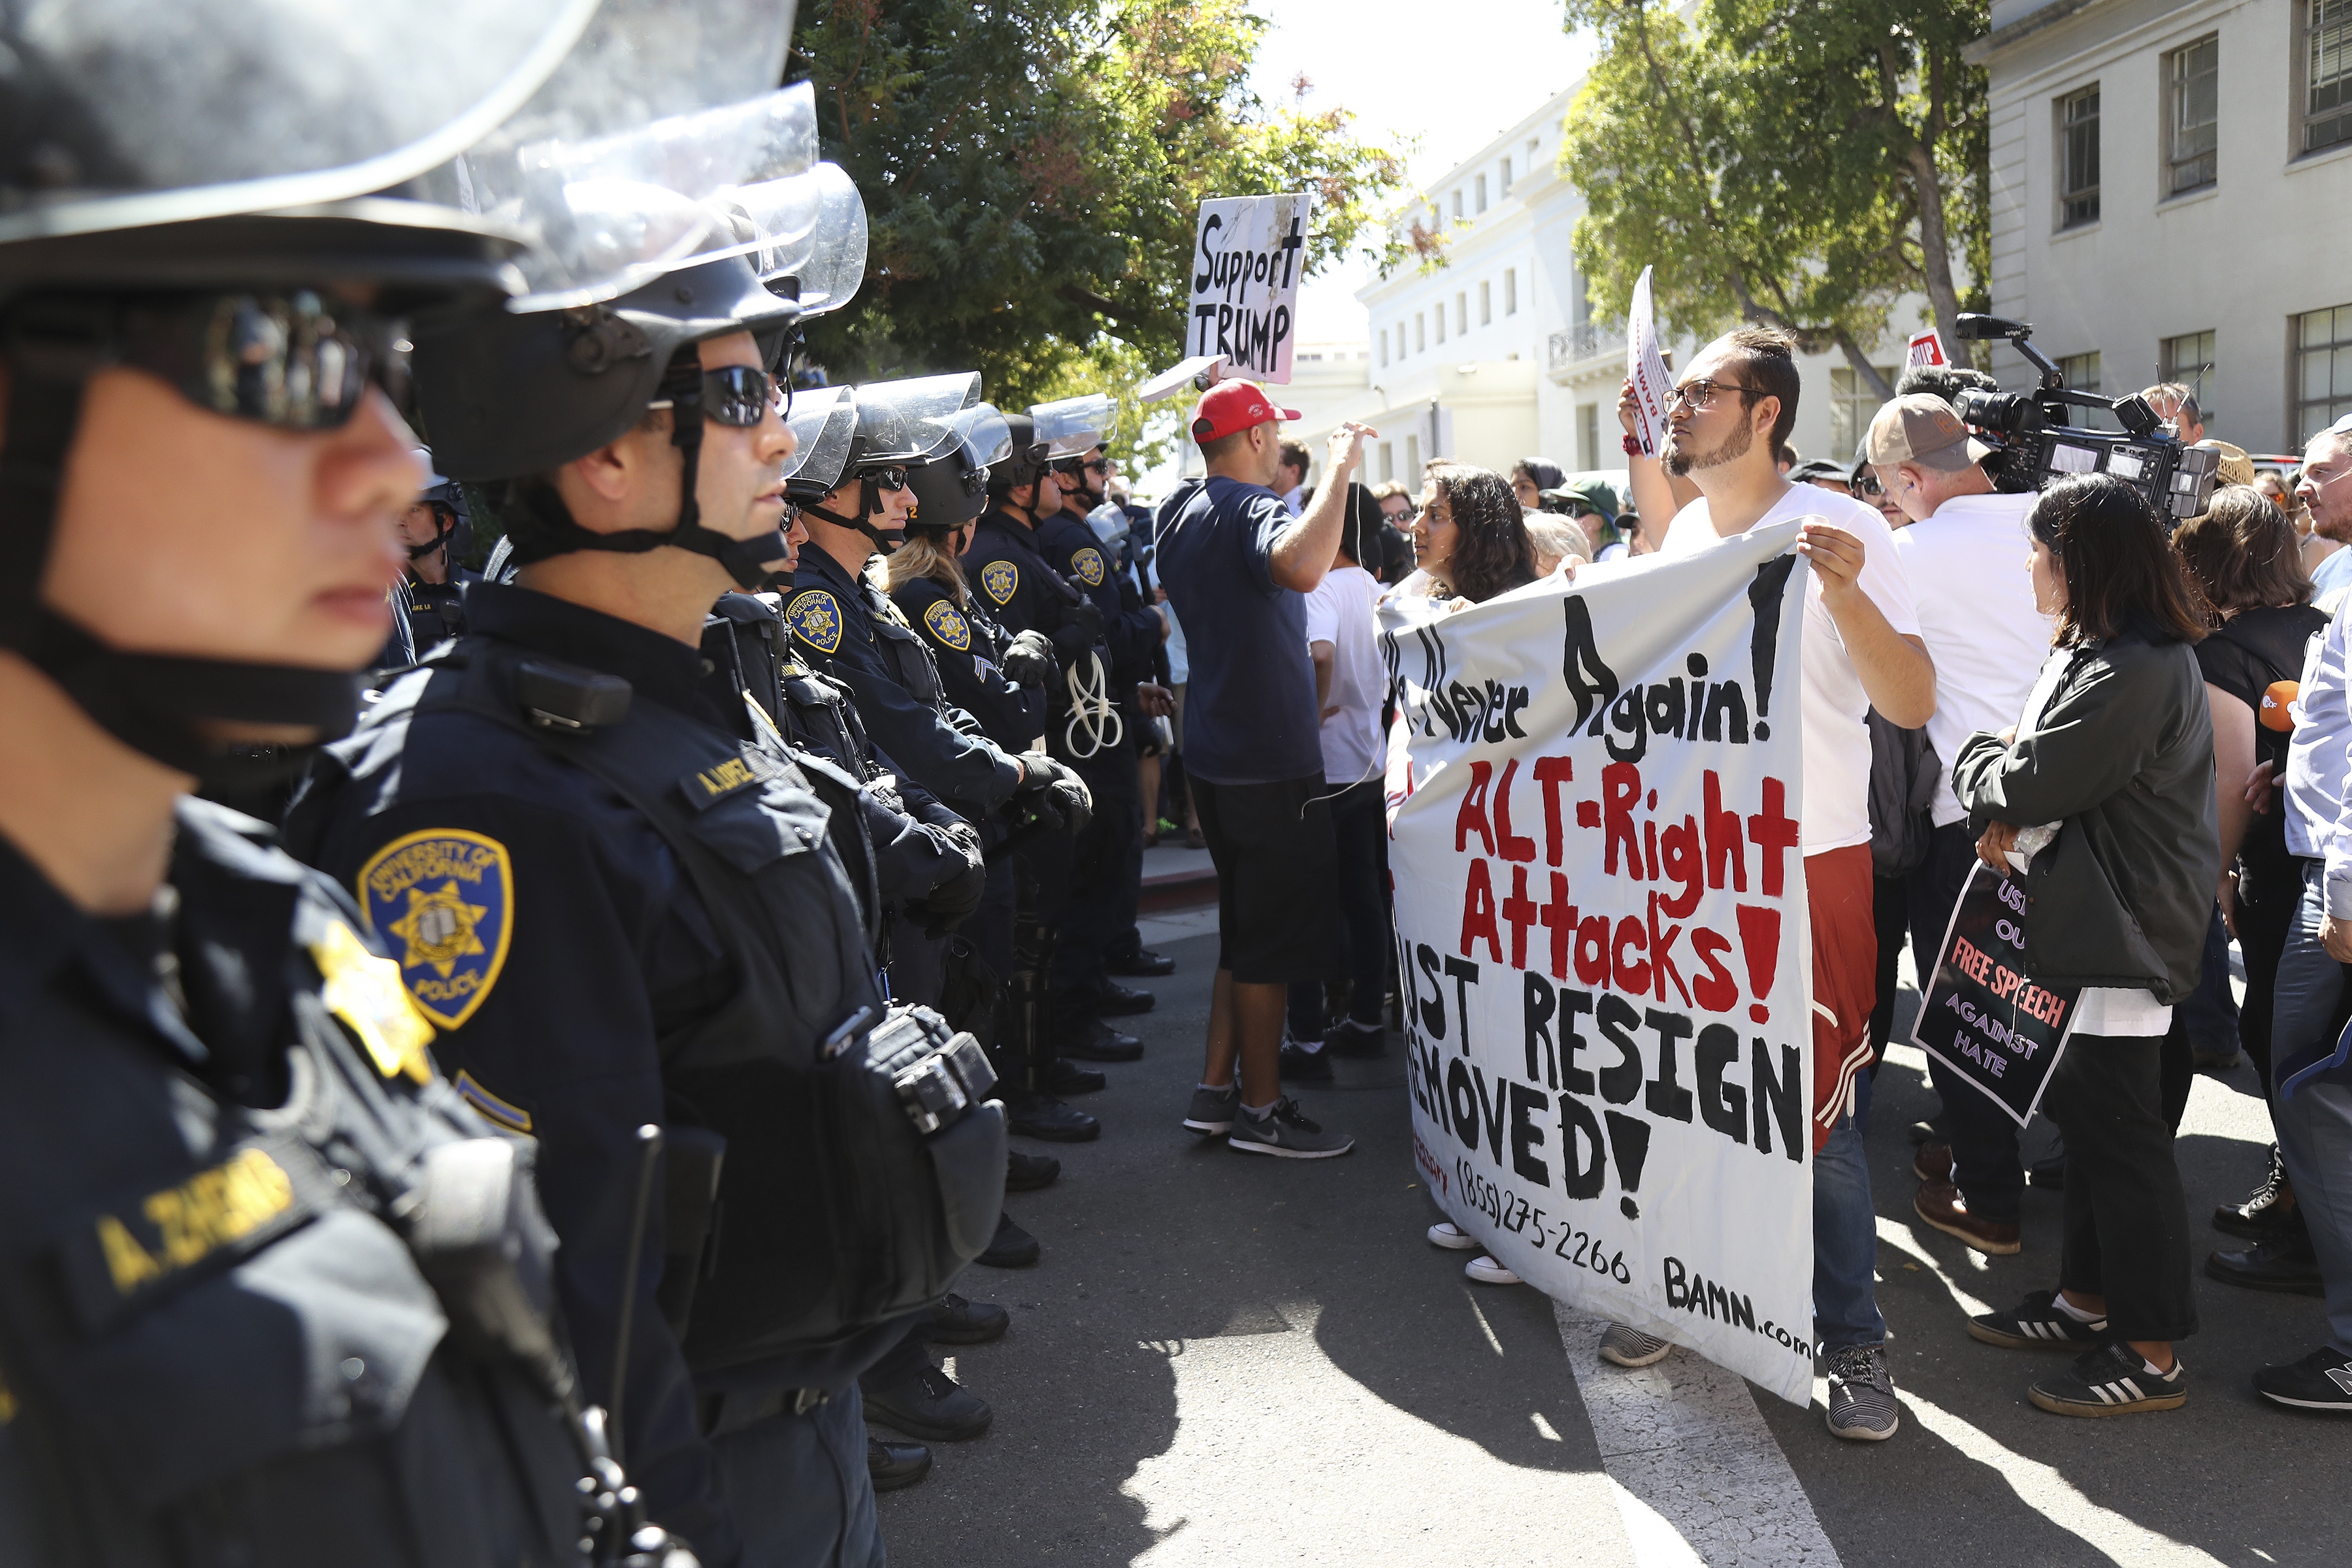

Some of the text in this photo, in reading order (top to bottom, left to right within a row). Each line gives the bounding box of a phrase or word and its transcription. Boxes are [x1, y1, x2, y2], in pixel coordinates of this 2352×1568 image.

[1196, 213, 1302, 304] Support
[1195, 303, 1290, 374] TRUMP
[789, 593, 820, 617] UNIVERSITY
[794, 598, 827, 619] CALIFORNIA
[816, 631, 838, 645] POLICE
[952, 634, 968, 645] POLICE
[1416, 622, 1529, 743] Never
[1563, 553, 1797, 763] Again!
[1456, 755, 1799, 919] ALT-Right
[1997, 879, 2025, 916] USI
[1460, 858, 1781, 1024] Attacks!
[1995, 919, 2025, 949] OU
[414, 967, 484, 1001] POLICE
[1951, 935, 2066, 1028] FREE SPEECH
[1396, 930, 1803, 1163] UST RESIGN
[1946, 992, 2038, 1061] AGAINST
[1953, 1030, 2008, 1078] HATE
[1663, 1256, 1812, 1360] BAMN.com
